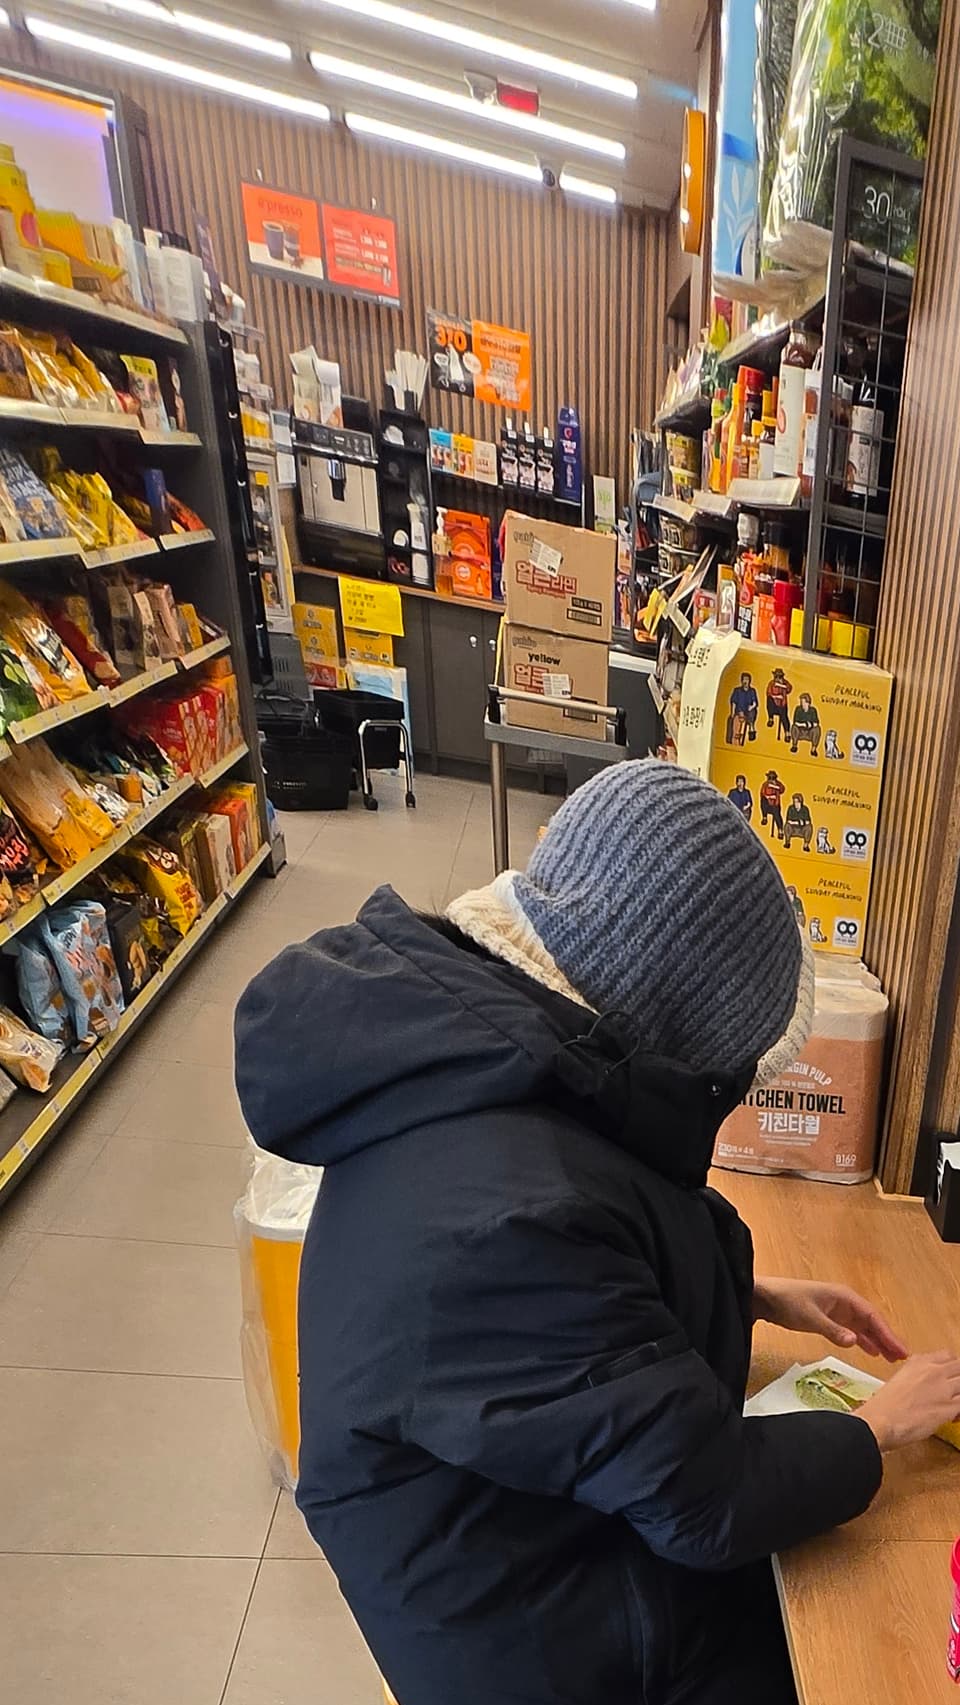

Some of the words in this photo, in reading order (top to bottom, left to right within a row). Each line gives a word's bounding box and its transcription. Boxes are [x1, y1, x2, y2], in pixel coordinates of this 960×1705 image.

[528, 653, 560, 666] yellow
[834, 684, 871, 700] PEACEFUL
[821, 695, 848, 708] SUNDAY
[849, 700, 883, 714] MORNING
[826, 785, 860, 799] PEACEFUL
[812, 794, 840, 806] SUNDAY
[841, 800, 872, 811] MORNING
[818, 878, 851, 891] PEACEFUL
[805, 887, 832, 898] SUNDAY
[833, 891, 862, 903] MORNING
[810, 1067, 832, 1087] PULP
[739, 1089, 794, 1110] CHEN
[798, 1092, 846, 1114] TOWEL
[758, 1111, 820, 1135] 키친타월
